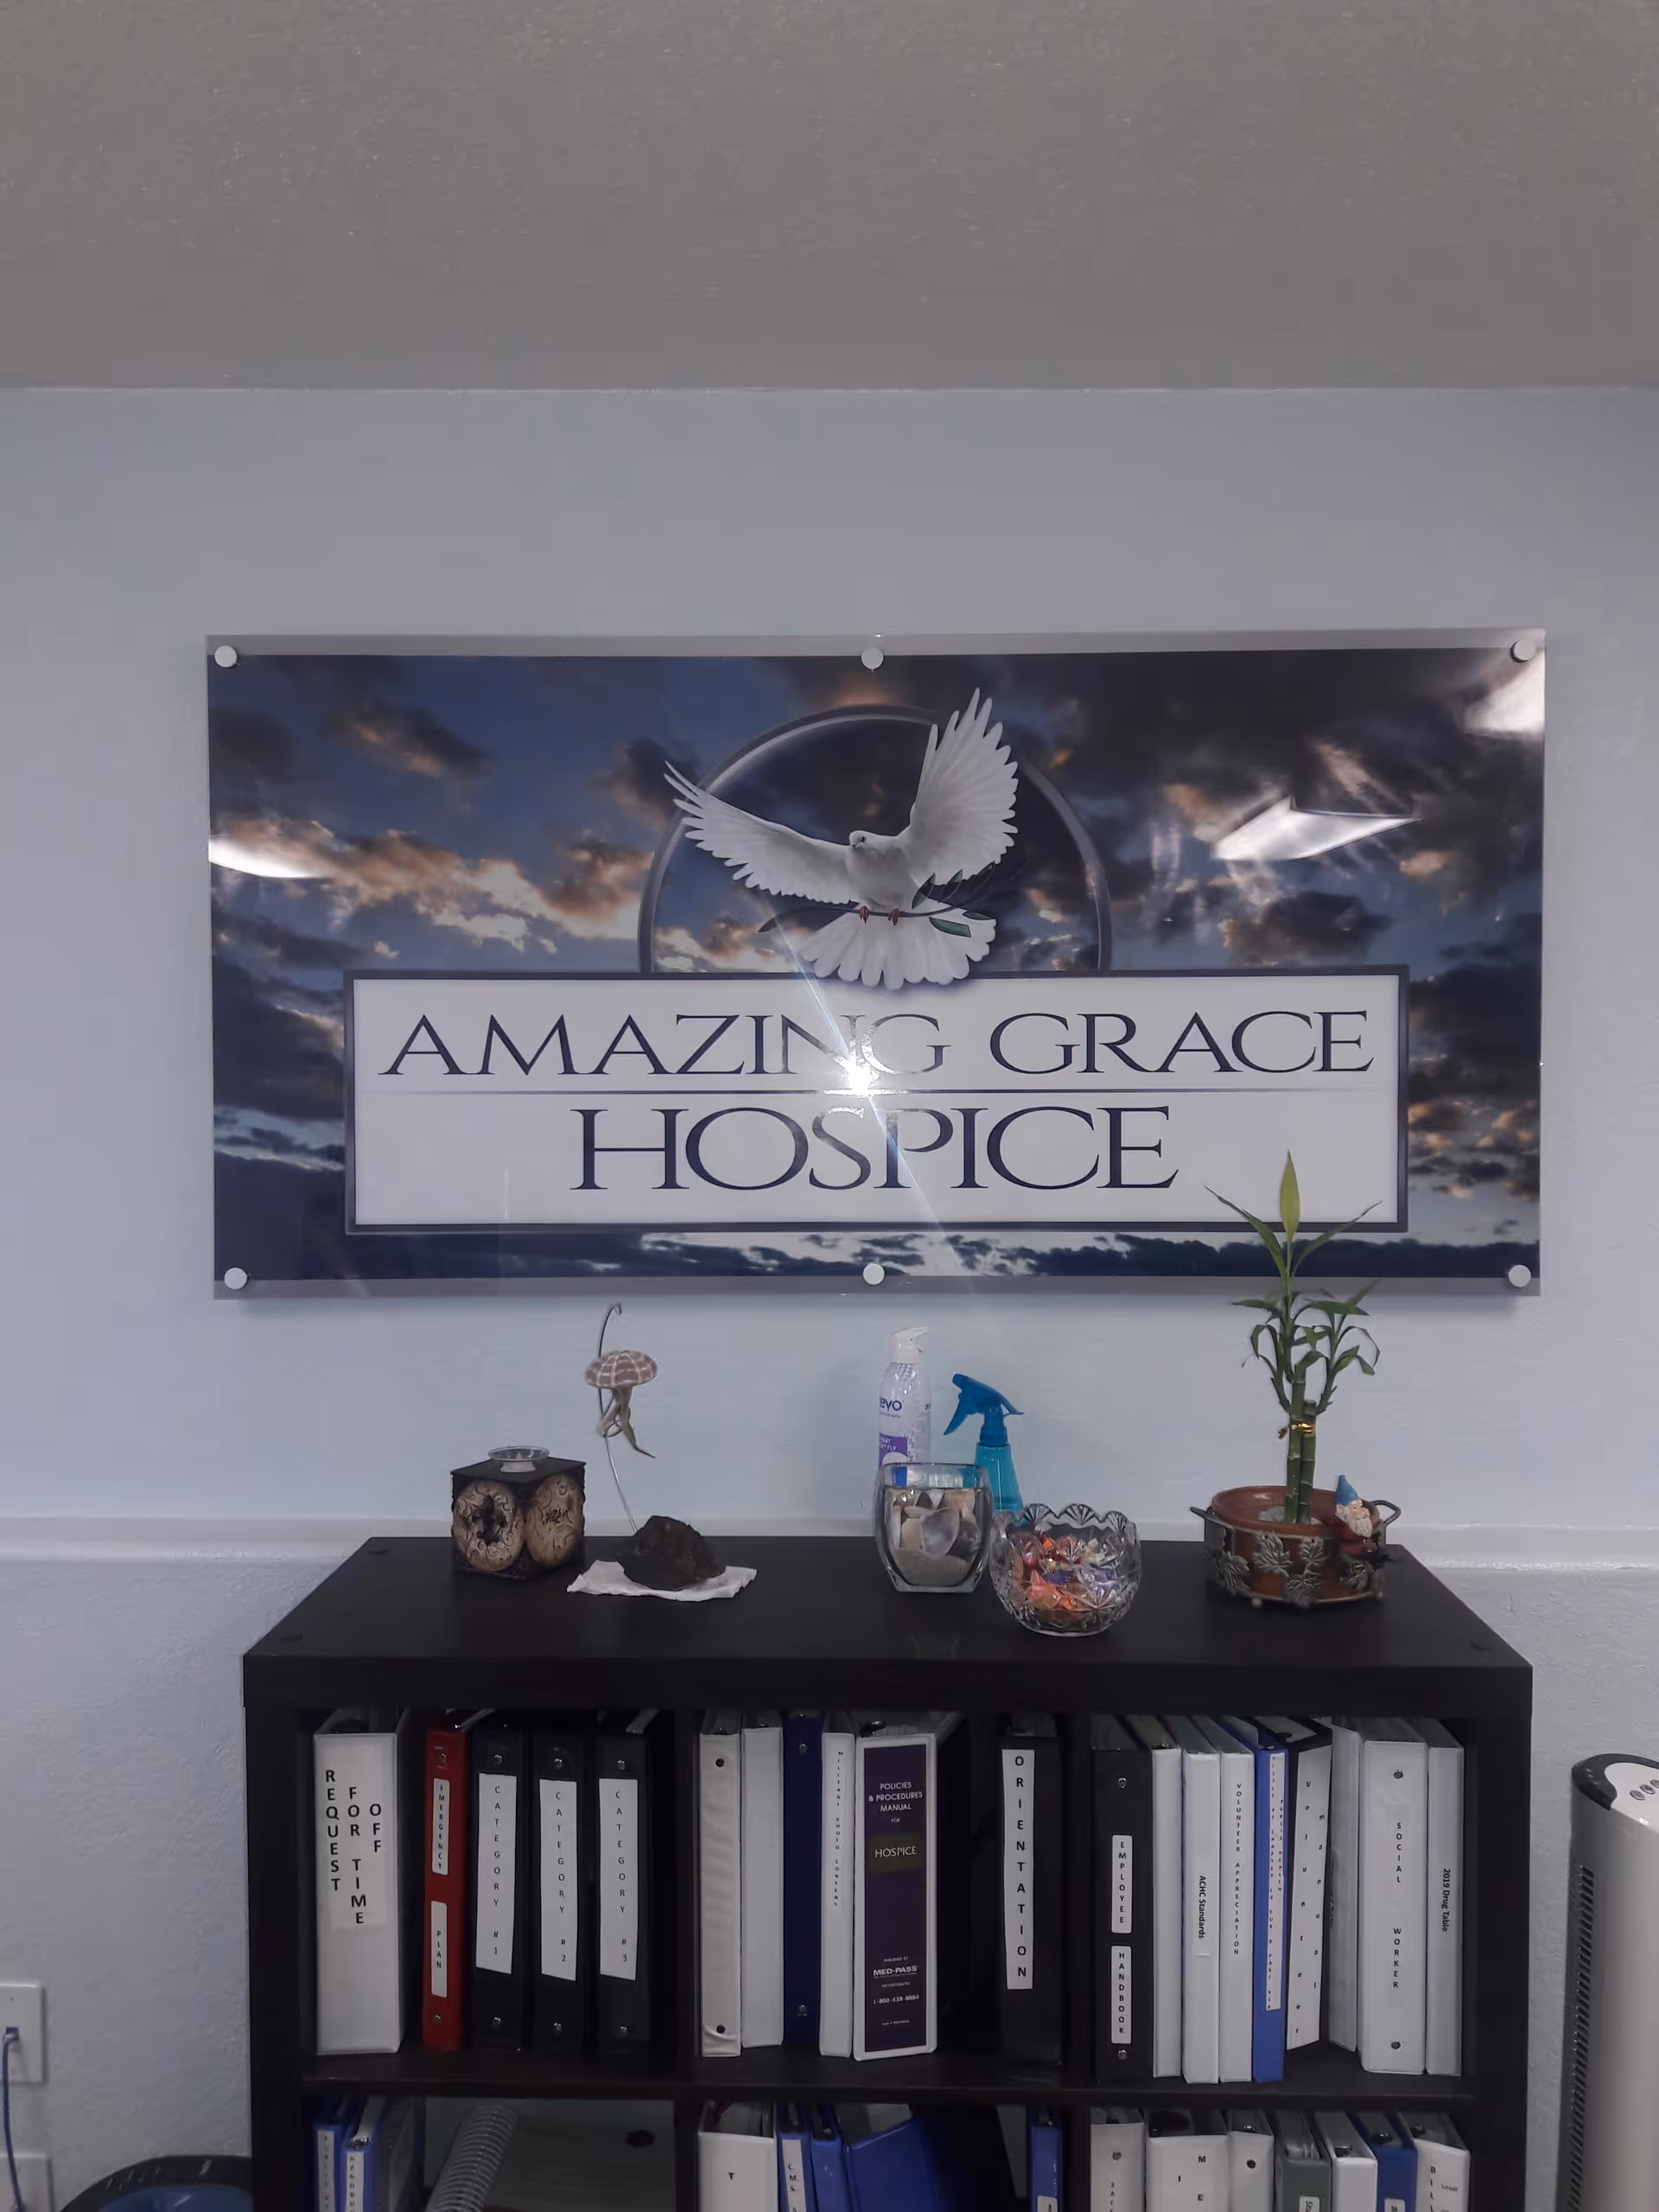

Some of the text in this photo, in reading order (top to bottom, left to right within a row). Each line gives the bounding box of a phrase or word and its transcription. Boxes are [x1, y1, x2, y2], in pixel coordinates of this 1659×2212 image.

[378, 1009, 1376, 1077] AMAZING GRACE
[569, 1105, 1180, 1192] HOSPICE
[868, 1791, 924, 1802] & PROCEDURES
[880, 1781, 912, 1791] POLICIES
[880, 1802, 912, 1813] MANUAL
[325, 1770, 341, 1892] REQUEST
[347, 1786, 367, 1924] FOR TIME
[369, 1803, 383, 1853] OFF
[437, 1783, 446, 1870] EMERGENCY
[493, 1786, 501, 1908] CATEGORY
[555, 1791, 566, 1915] CATEGORY
[614, 1790, 627, 1914] CATEGORY
[874, 1846, 918, 1859] HOSPICE
[1014, 1755, 1028, 1979] ORIENTATION
[1117, 1840, 1127, 1924] EMPLOYEE
[1440, 1868, 1452, 1932] 2019 Drug Table
[1198, 1874, 1207, 1940] ACHC Standards
[1392, 1927, 1402, 1989] WORKER
